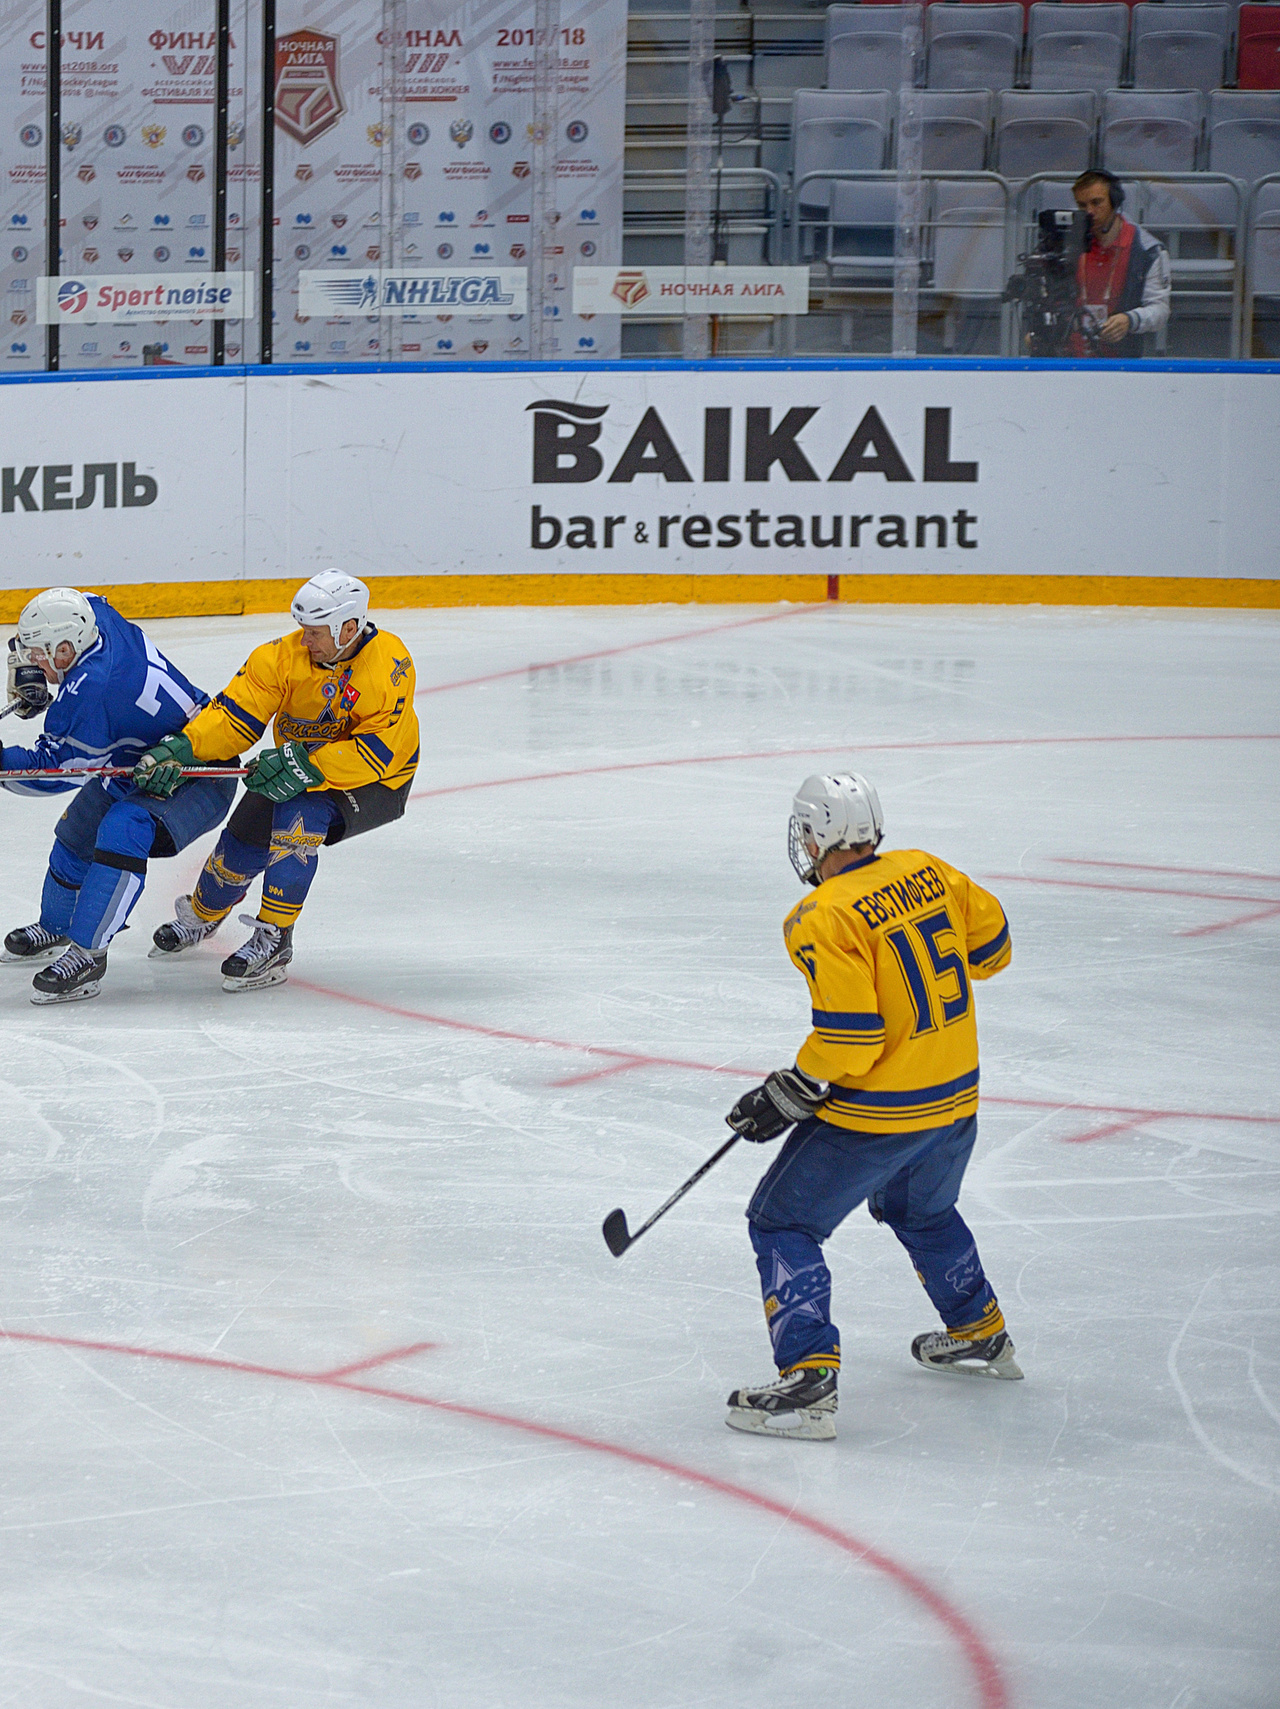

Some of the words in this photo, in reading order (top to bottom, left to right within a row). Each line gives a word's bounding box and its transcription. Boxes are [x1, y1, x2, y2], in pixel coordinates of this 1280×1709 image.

[29, 31, 105, 50] СЧИ
[278, 41, 335, 52] НОЧНАЯ
[286, 53, 326, 65] ЛИГА
[203, 87, 244, 96] ХОЕЯ
[384, 277, 502, 304] NHLIGA
[659, 283, 734, 297] НОЧНАЯ
[740, 284, 786, 297] ЛИГА
[524, 399, 980, 484] BAIKAL
[530, 504, 627, 549] bar
[634, 520, 650, 544] &
[657, 509, 979, 548] restaurant
[282, 742, 314, 785] ASTON
[852, 865, 947, 931] ЕВСТИФЕЕВ
[883, 904, 970, 1040] 15
